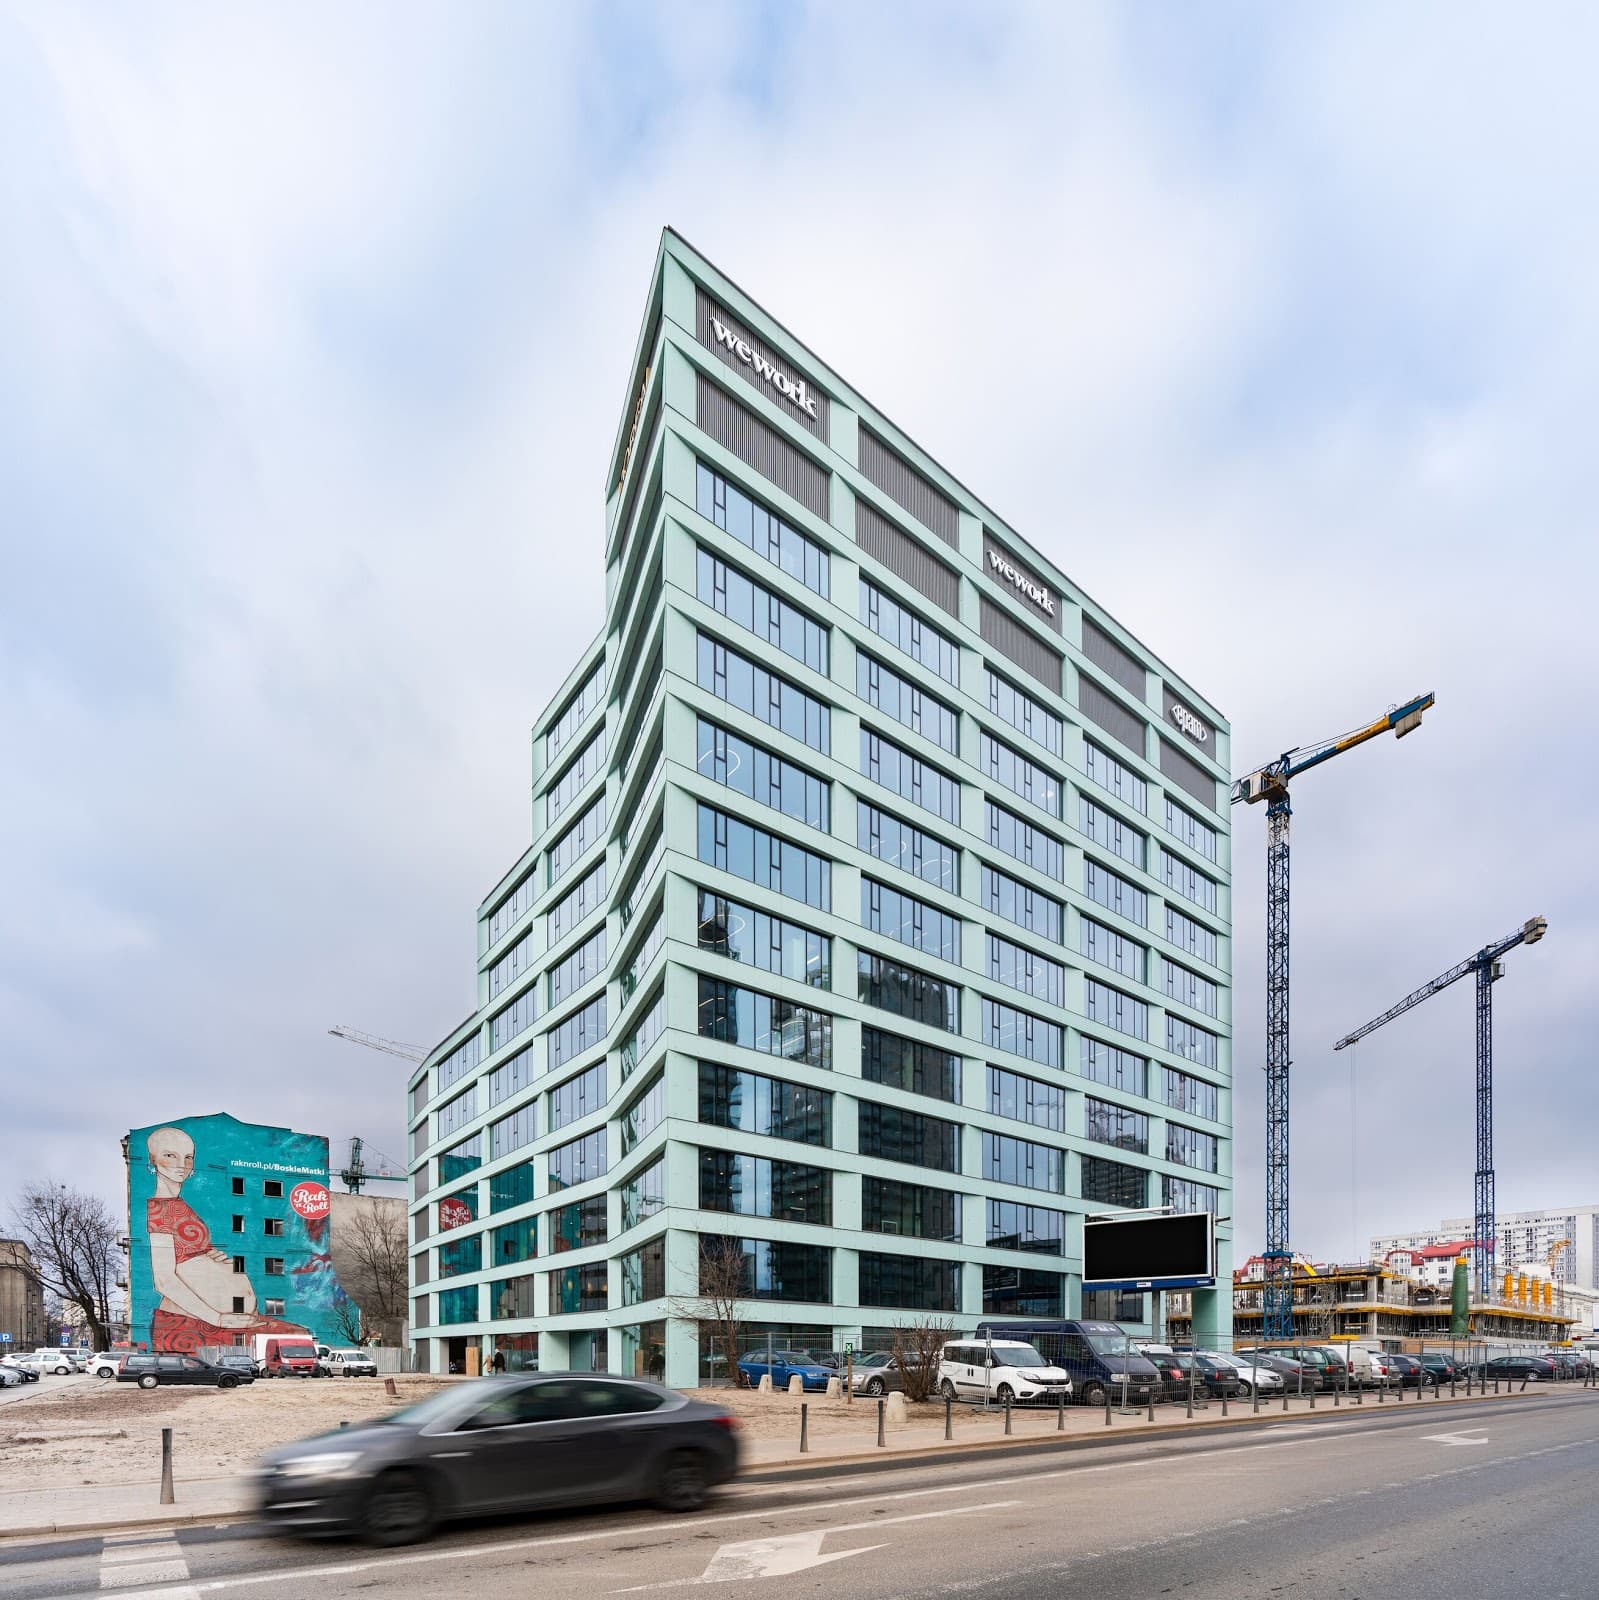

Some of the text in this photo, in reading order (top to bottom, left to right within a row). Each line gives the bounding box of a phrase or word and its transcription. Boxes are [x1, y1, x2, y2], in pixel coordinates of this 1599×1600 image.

[710, 316, 818, 419] wework
[986, 549, 1055, 617] wework
[231, 1160, 325, 1175] raknroll.pl/BoskieMatki
[294, 1189, 329, 1203] Rak
[303, 1201, 329, 1213] Roll
[2, 1333, 10, 1341] P
